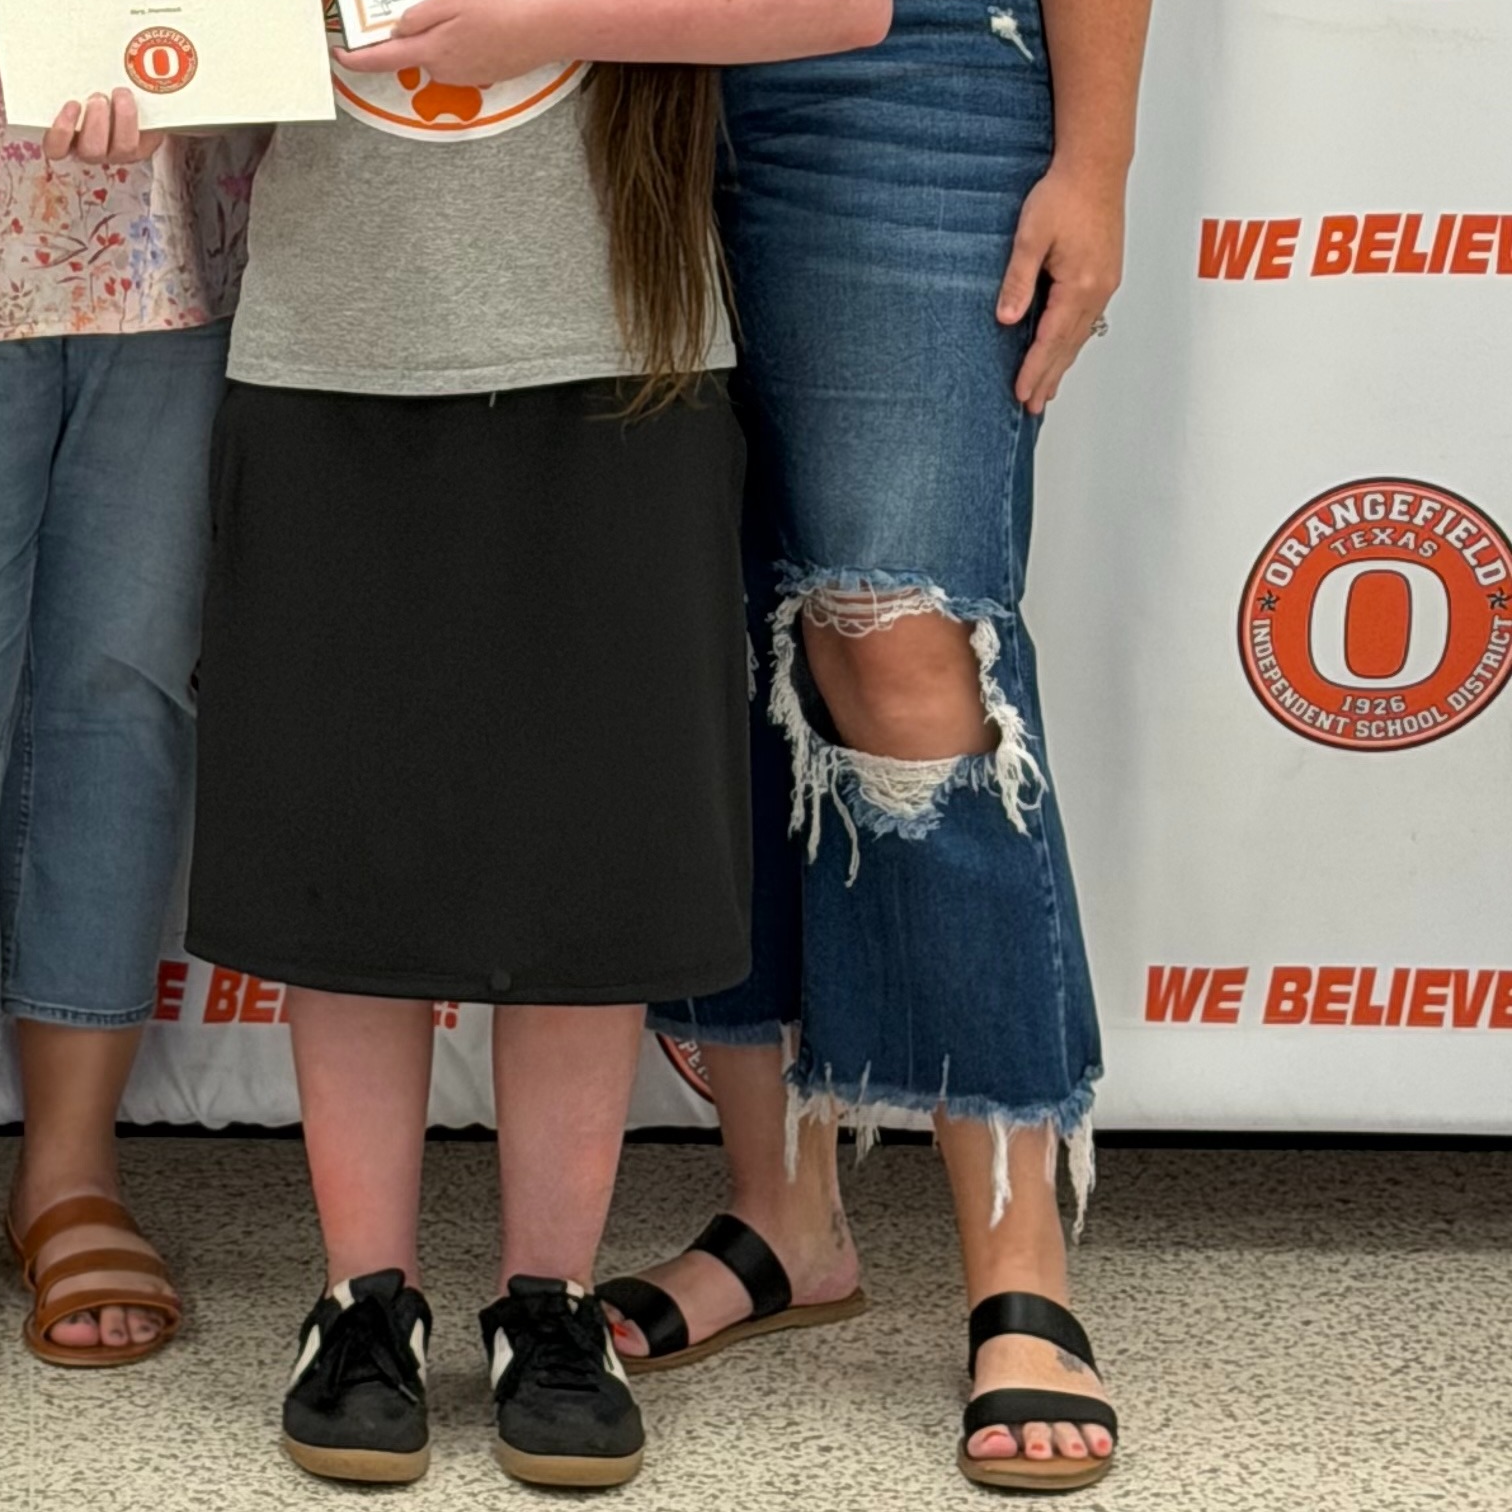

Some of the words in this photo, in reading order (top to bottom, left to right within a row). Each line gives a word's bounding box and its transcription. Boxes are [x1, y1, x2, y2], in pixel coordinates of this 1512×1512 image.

[143, 46, 179, 79] O
[1199, 219, 1301, 280] WE
[1265, 493, 1507, 587] ORANGEFIELD
[1330, 529, 1438, 558] TEXAS
[1310, 559, 1450, 689] O
[1252, 619, 1349, 734] INDEPENDENT
[1355, 706, 1448, 738] SCHOOL
[1447, 616, 1512, 712] DISTRICT
[1342, 695, 1406, 714] 1926
[1145, 967, 1248, 1024] WE
[1265, 966, 1512, 1029] BELIEVE
